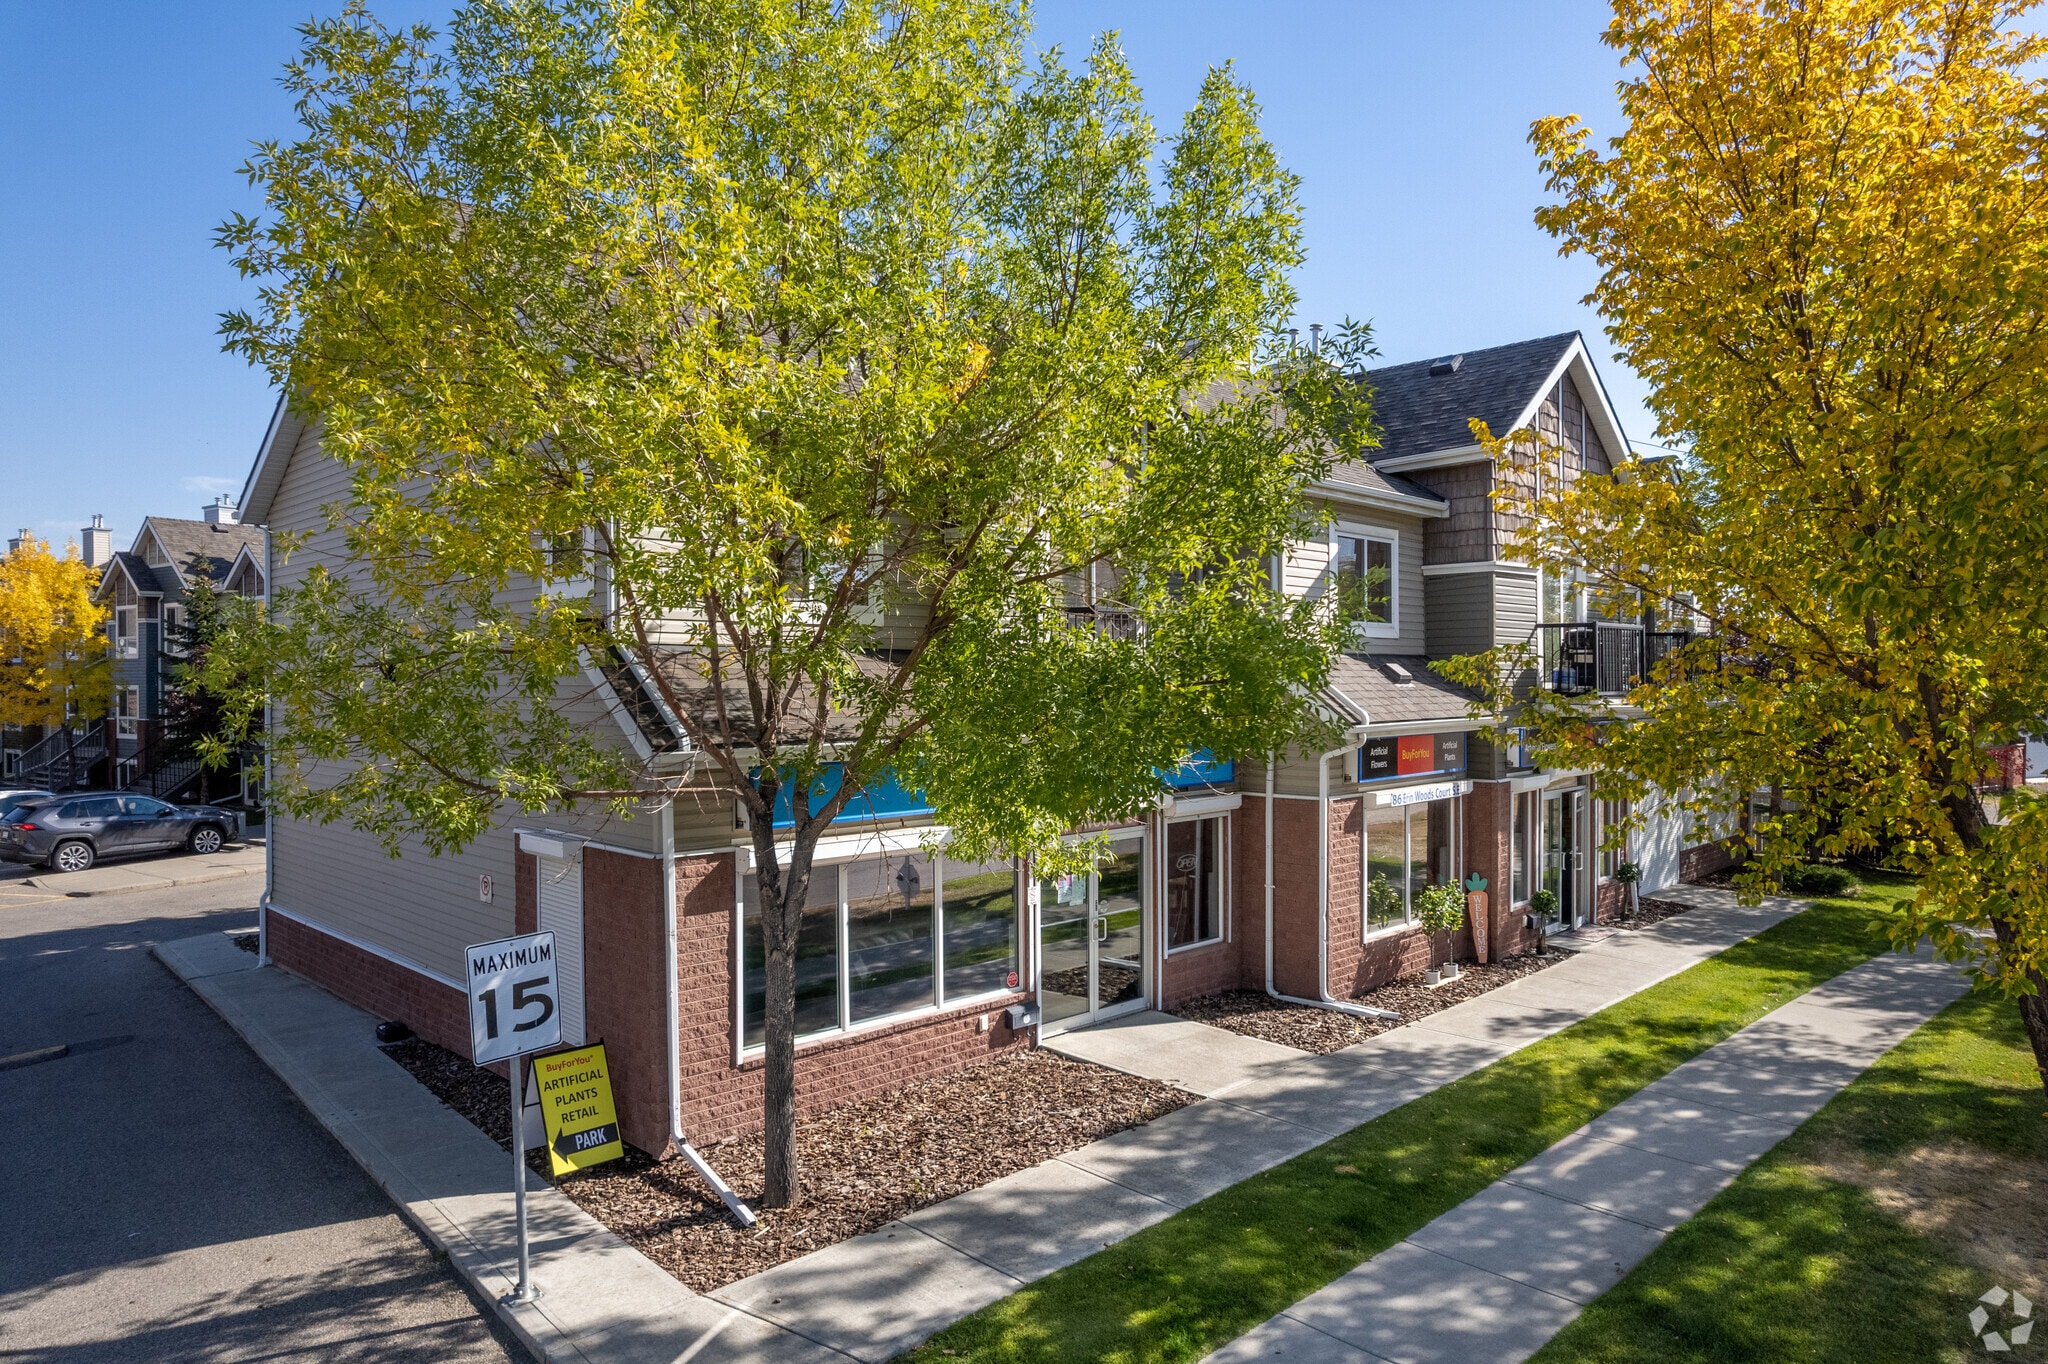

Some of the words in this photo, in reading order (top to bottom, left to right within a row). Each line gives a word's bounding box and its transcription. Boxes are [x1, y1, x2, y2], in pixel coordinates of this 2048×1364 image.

[1370, 746, 1388, 756] Artificial
[1442, 740, 1458, 750] Artificial
[1401, 748, 1430, 761] BuyForYou
[1444, 753, 1456, 761] Plants
[1370, 760, 1388, 769] Flowers
[1403, 793, 1413, 803] Erin
[1414, 789, 1434, 801] Woods
[1435, 787, 1451, 798] Court
[1177, 857, 1197, 869] OPEN
[1473, 894, 1486, 954] WELCOME
[473, 943, 551, 976] MAXIMUM
[478, 976, 554, 1040] 15
[546, 1056, 591, 1072] BuyForYou
[543, 1068, 604, 1092] ARTIFICIAL
[555, 1087, 598, 1107] PLANTS
[561, 1105, 599, 1124] RETAIL
[575, 1127, 608, 1150] PARK
